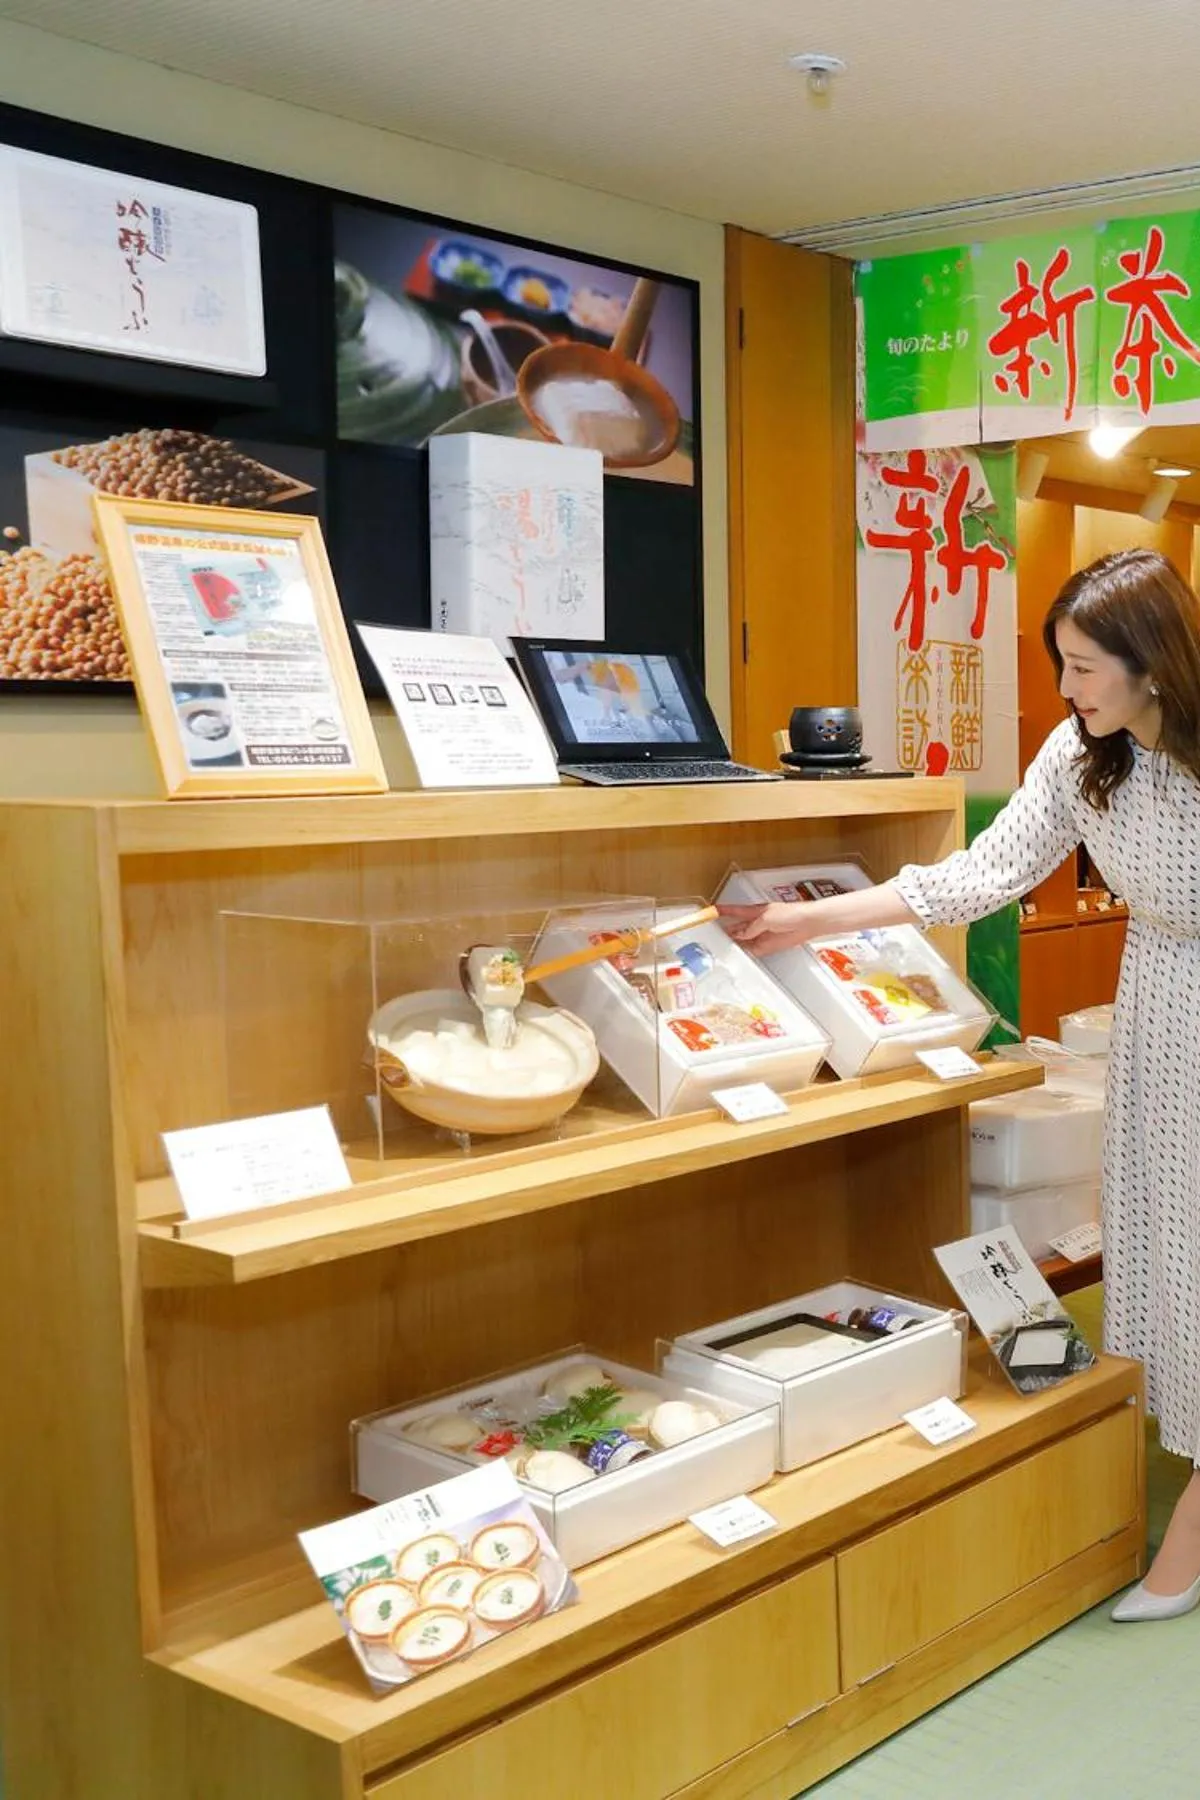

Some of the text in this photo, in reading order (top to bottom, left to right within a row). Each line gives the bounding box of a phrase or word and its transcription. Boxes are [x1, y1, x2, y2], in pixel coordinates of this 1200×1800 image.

[886, 329, 969, 356] 旬のたより
